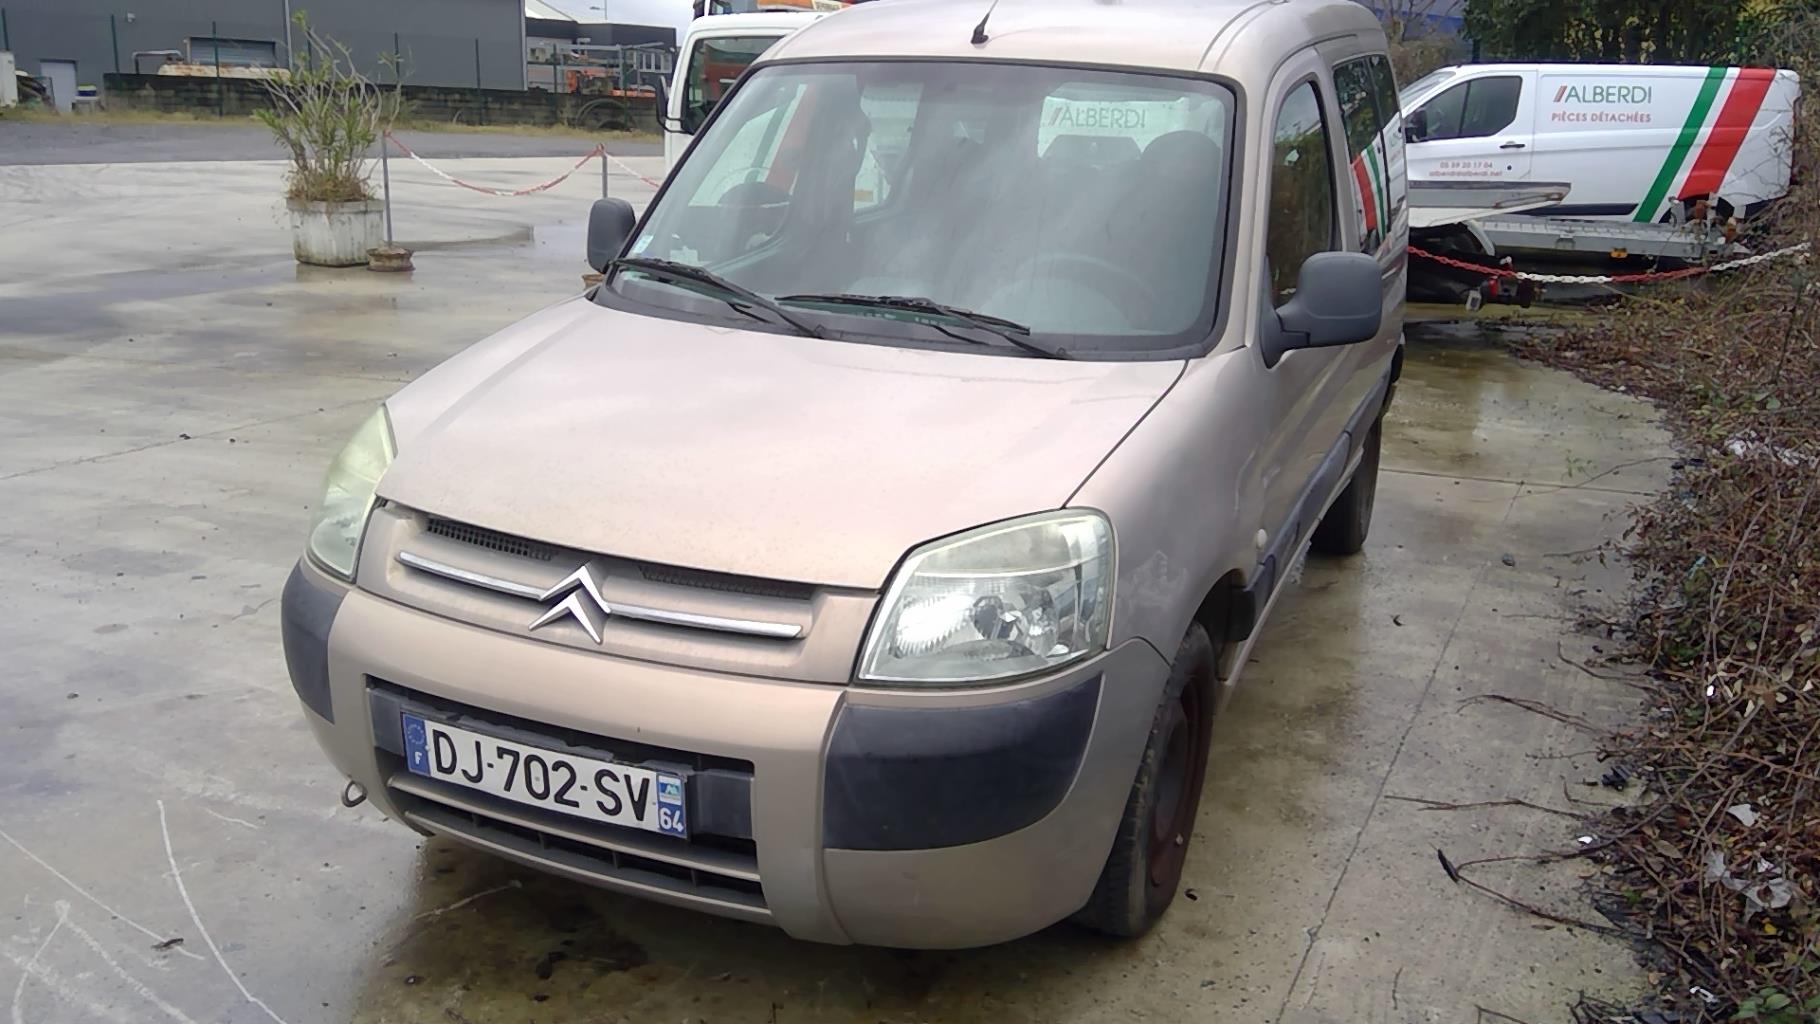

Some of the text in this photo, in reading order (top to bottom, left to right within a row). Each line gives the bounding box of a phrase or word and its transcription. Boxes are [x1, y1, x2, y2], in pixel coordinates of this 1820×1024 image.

[1564, 85, 1652, 104] ALBERDI
[1551, 110, 1652, 123] PIÈCES DÉTACHÉES
[414, 751, 423, 765] F
[431, 728, 651, 822] DJ-702-SV
[659, 807, 684, 832] 64
